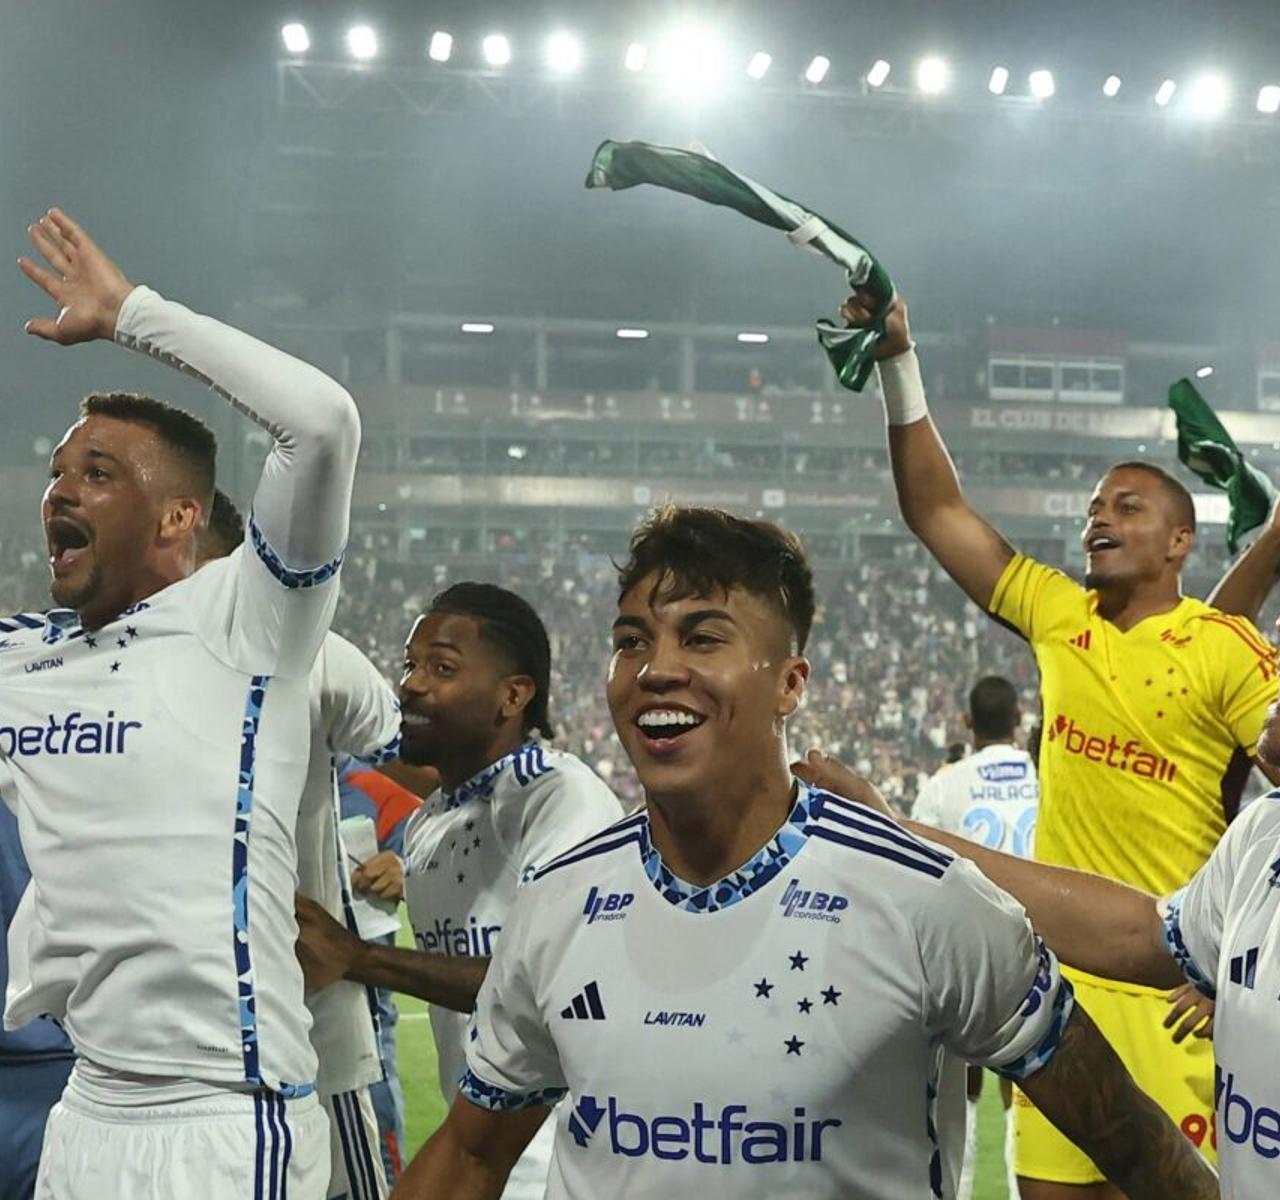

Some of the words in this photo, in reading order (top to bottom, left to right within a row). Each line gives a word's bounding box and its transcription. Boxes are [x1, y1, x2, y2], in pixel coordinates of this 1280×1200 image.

[24, 656, 64, 674] LAVITAN
[644, 1011, 706, 1027] LAVITAN
[608, 1096, 843, 1166] betfair
